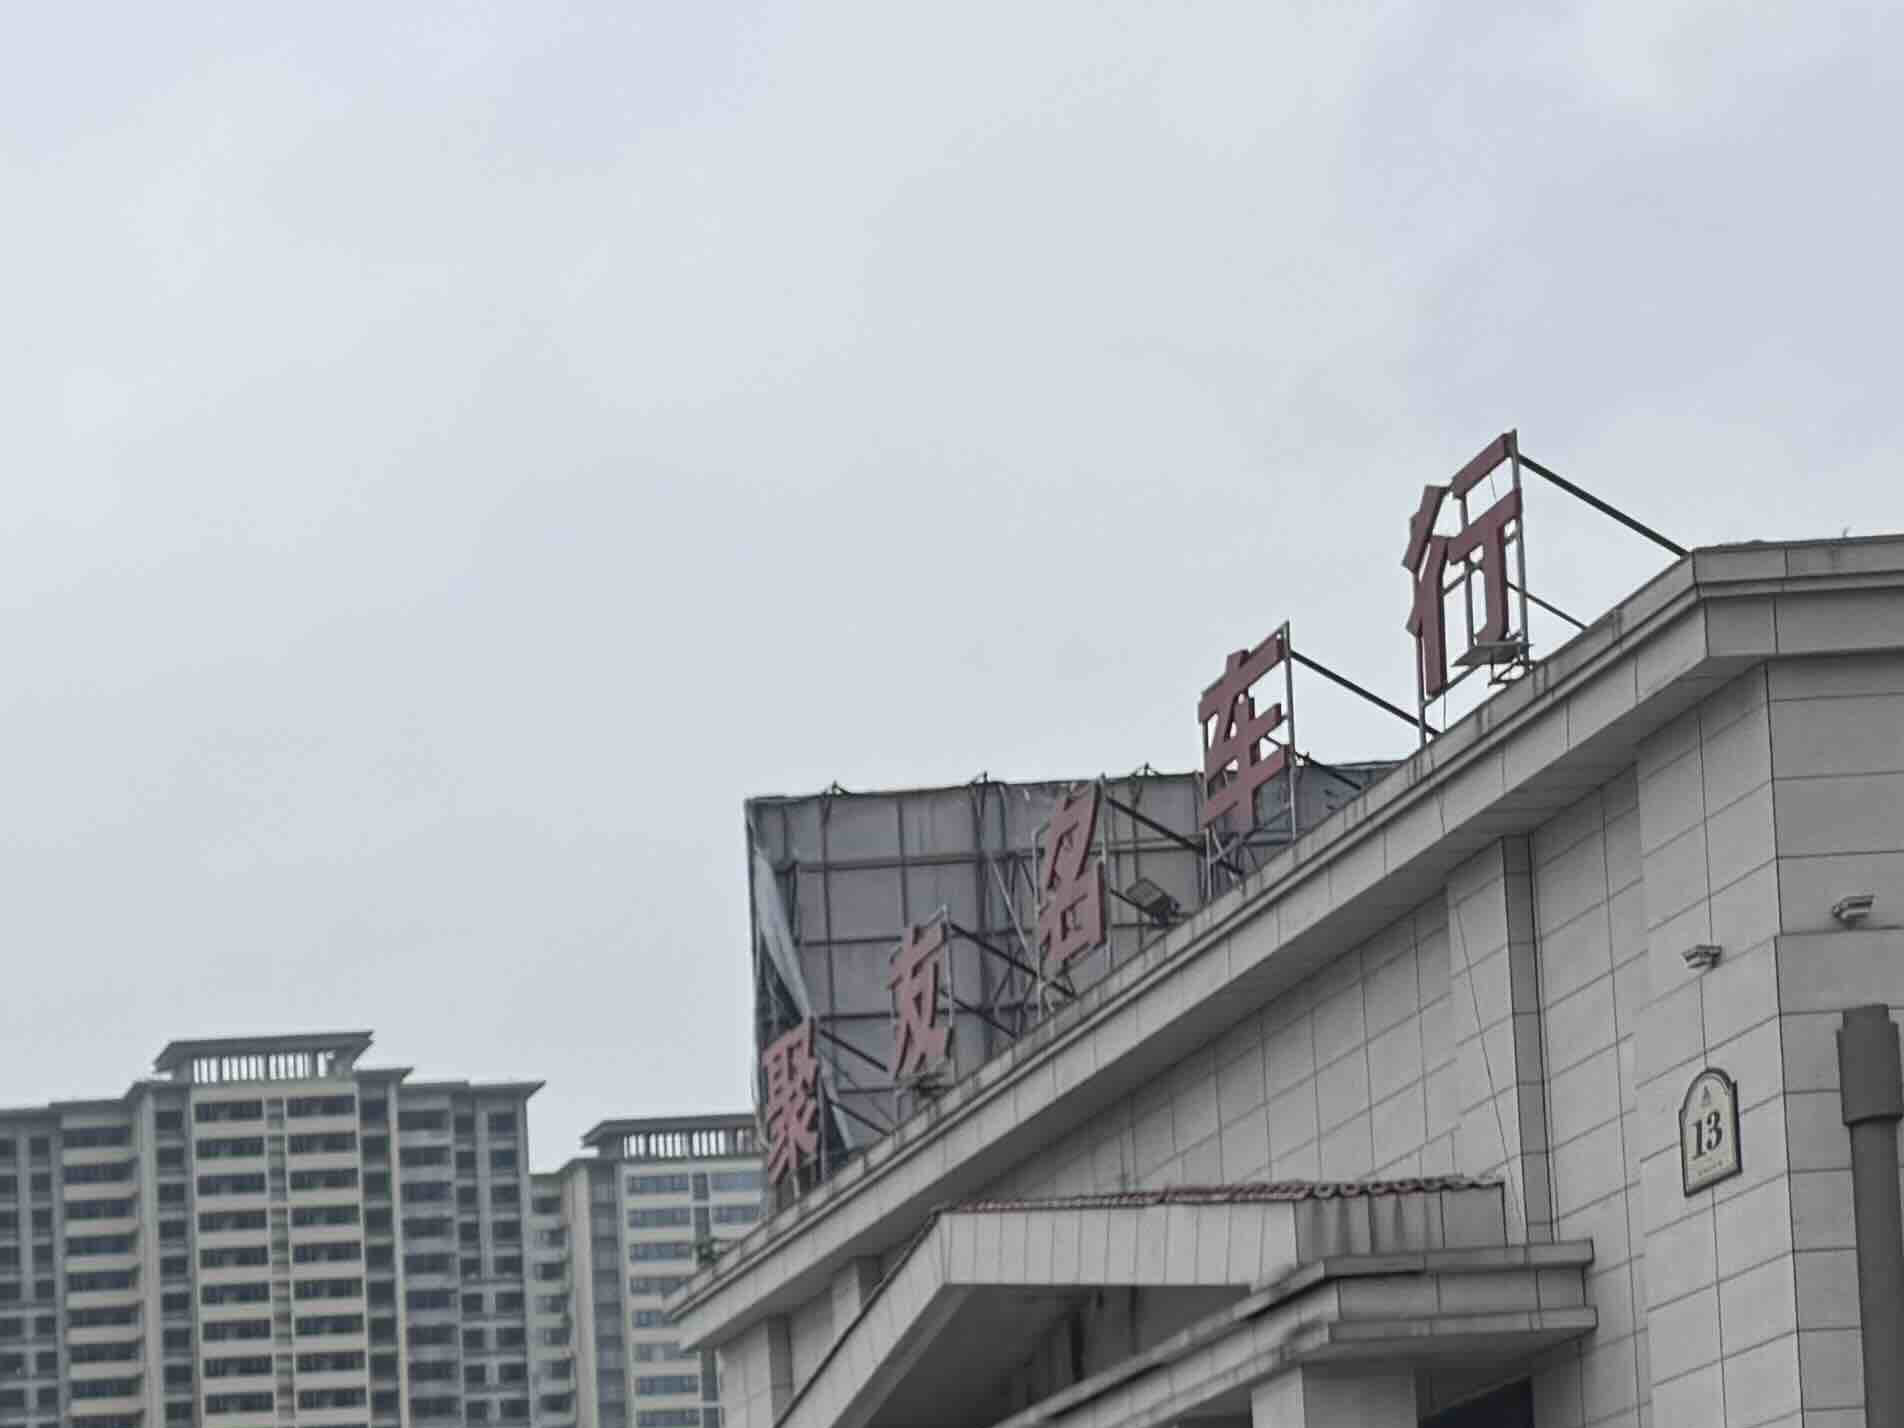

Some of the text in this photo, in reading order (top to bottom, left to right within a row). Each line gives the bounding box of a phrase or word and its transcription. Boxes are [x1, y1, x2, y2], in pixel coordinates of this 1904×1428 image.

[761, 431, 1522, 1187] 聚友名车行
[1689, 1110, 1723, 1160] 13
